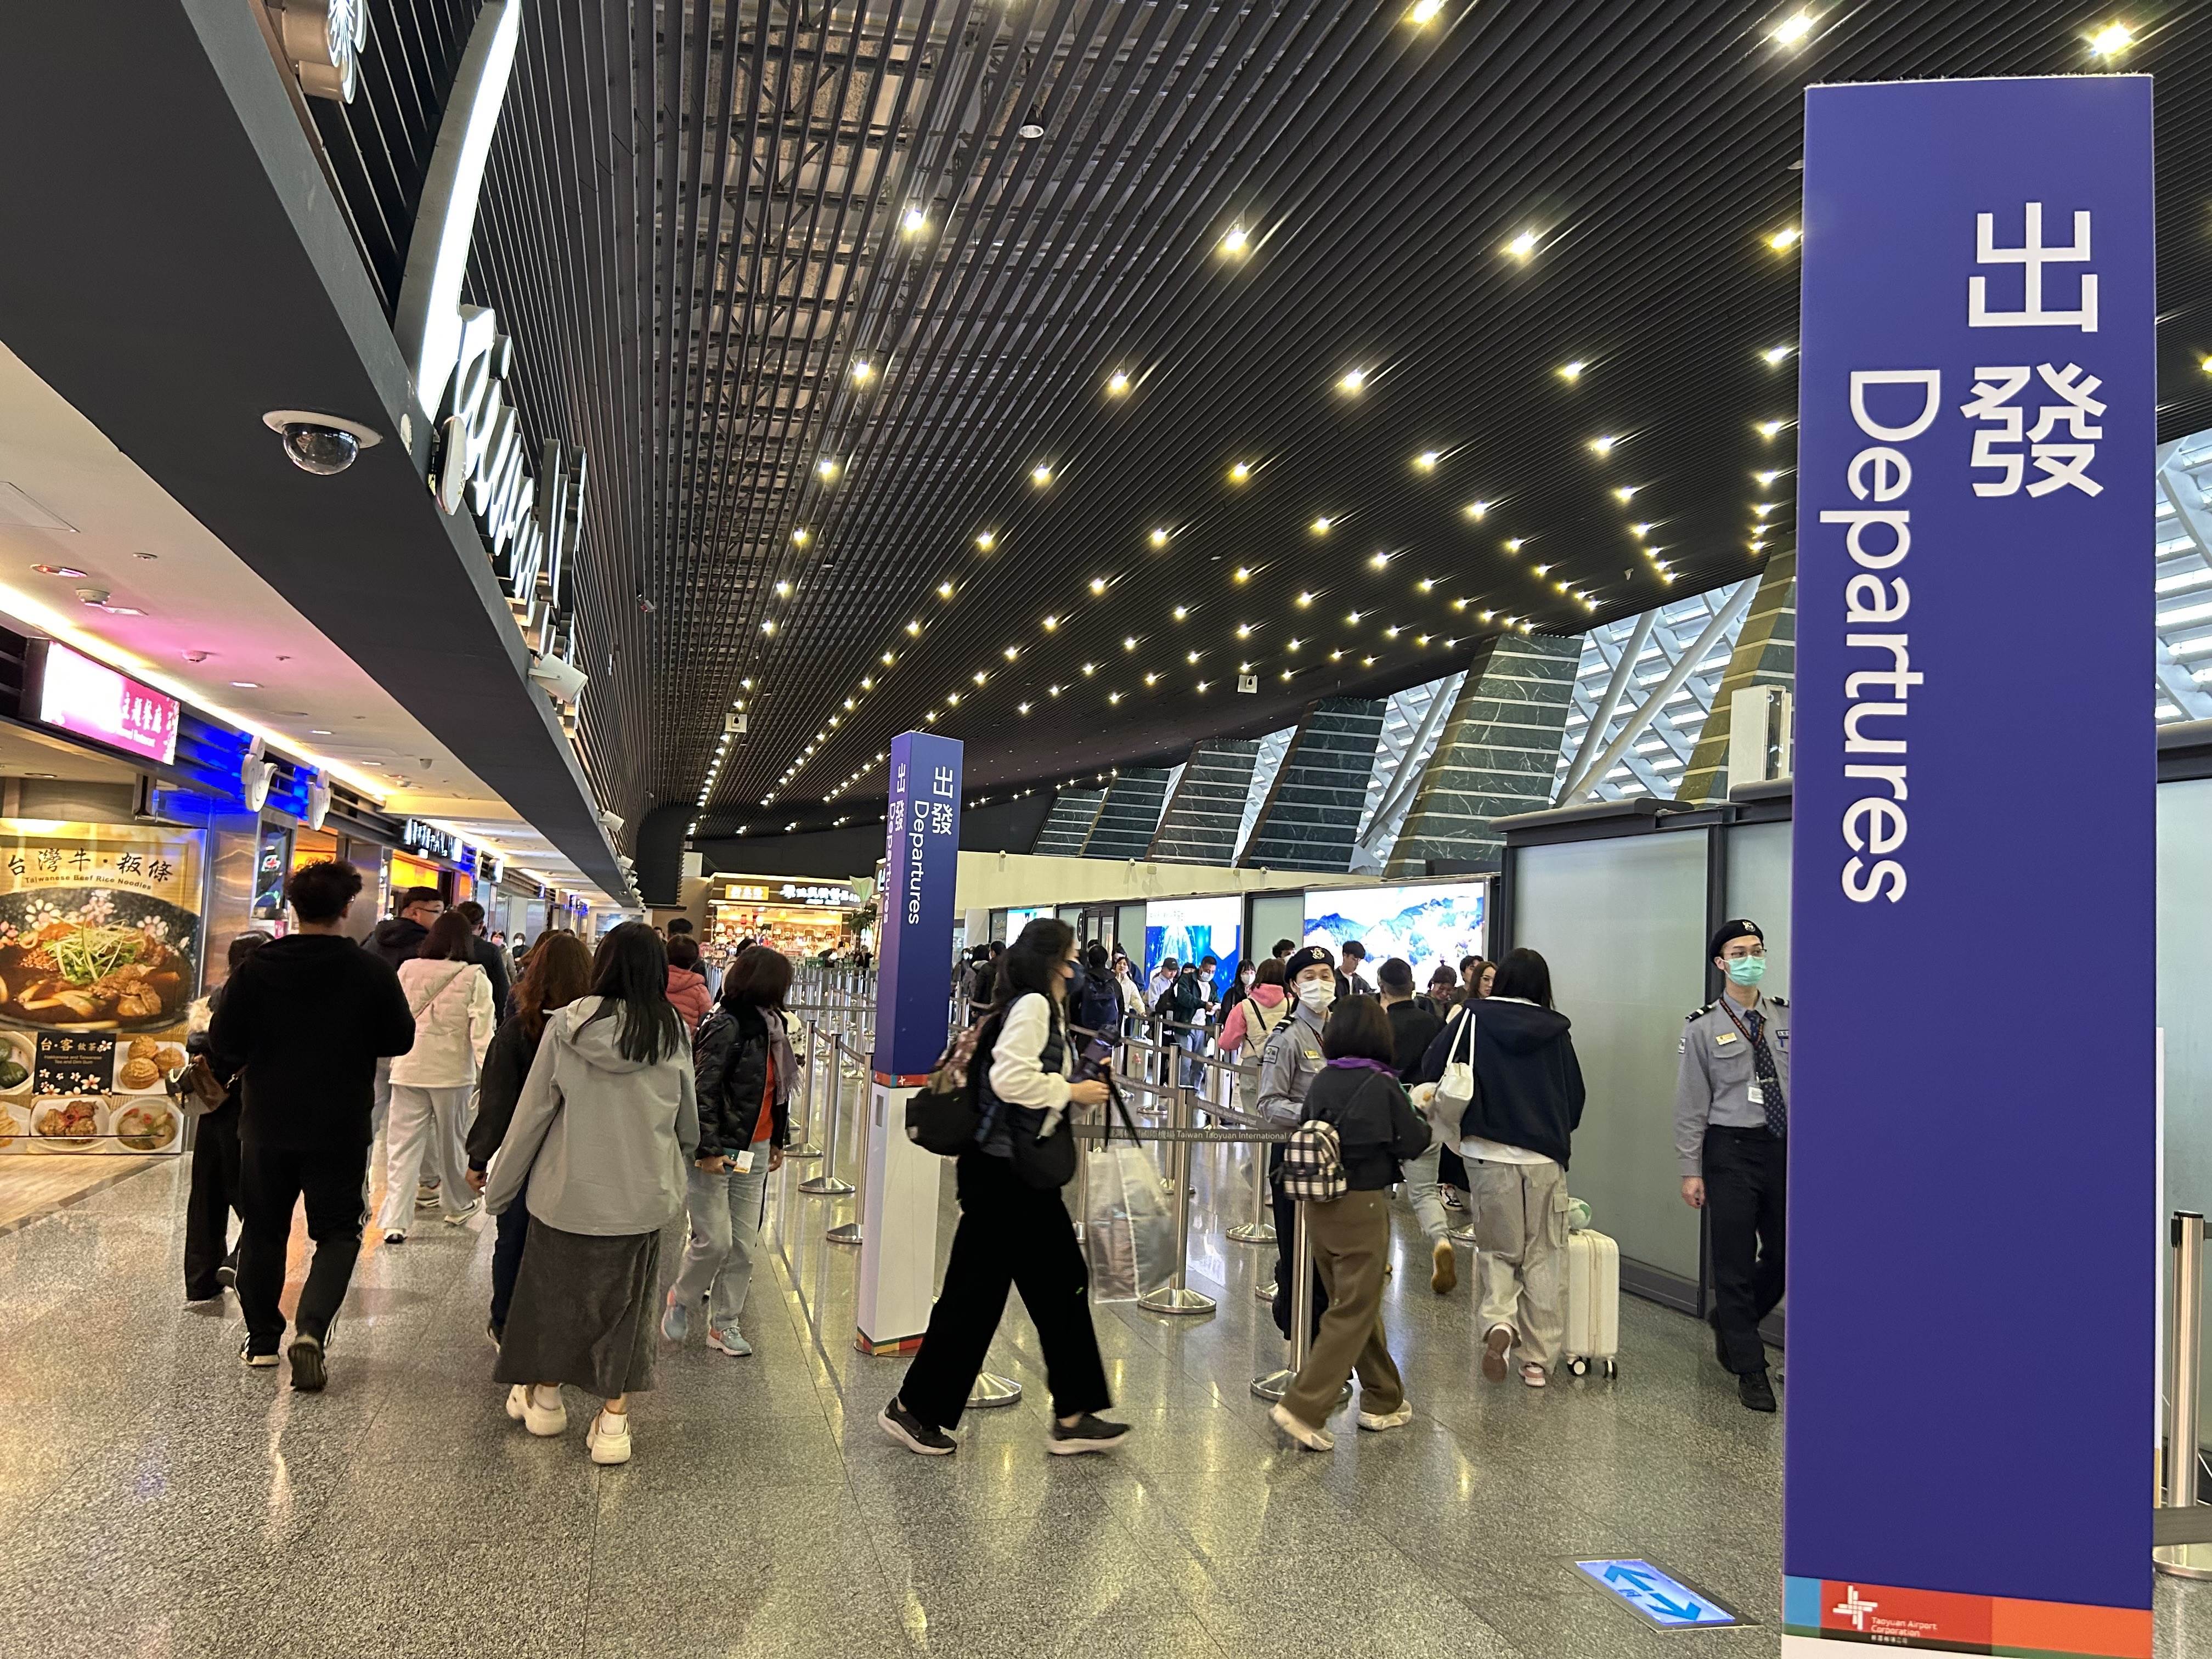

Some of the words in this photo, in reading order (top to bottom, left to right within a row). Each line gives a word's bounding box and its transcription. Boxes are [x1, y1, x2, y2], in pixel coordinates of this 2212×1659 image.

[1960, 201, 2108, 498] 出發
[1819, 369, 1941, 904] Departures
[895, 763, 906, 832] 出發
[931, 766, 953, 836] 出發
[25, 875, 70, 884] Taiwanese
[96, 875, 115, 883] Rice
[117, 878, 152, 890] Noodles
[883, 802, 896, 924] Departures
[908, 800, 930, 925] Departures
[1177, 1130, 1203, 1139] Taiwan
[1205, 1130, 1237, 1141] Taoyuan
[1239, 1130, 1286, 1139] International
[1871, 1616, 1906, 1627] Taoyuan
[1907, 1620, 1938, 1630] Airport
[1871, 1624, 1920, 1637] Corporation
